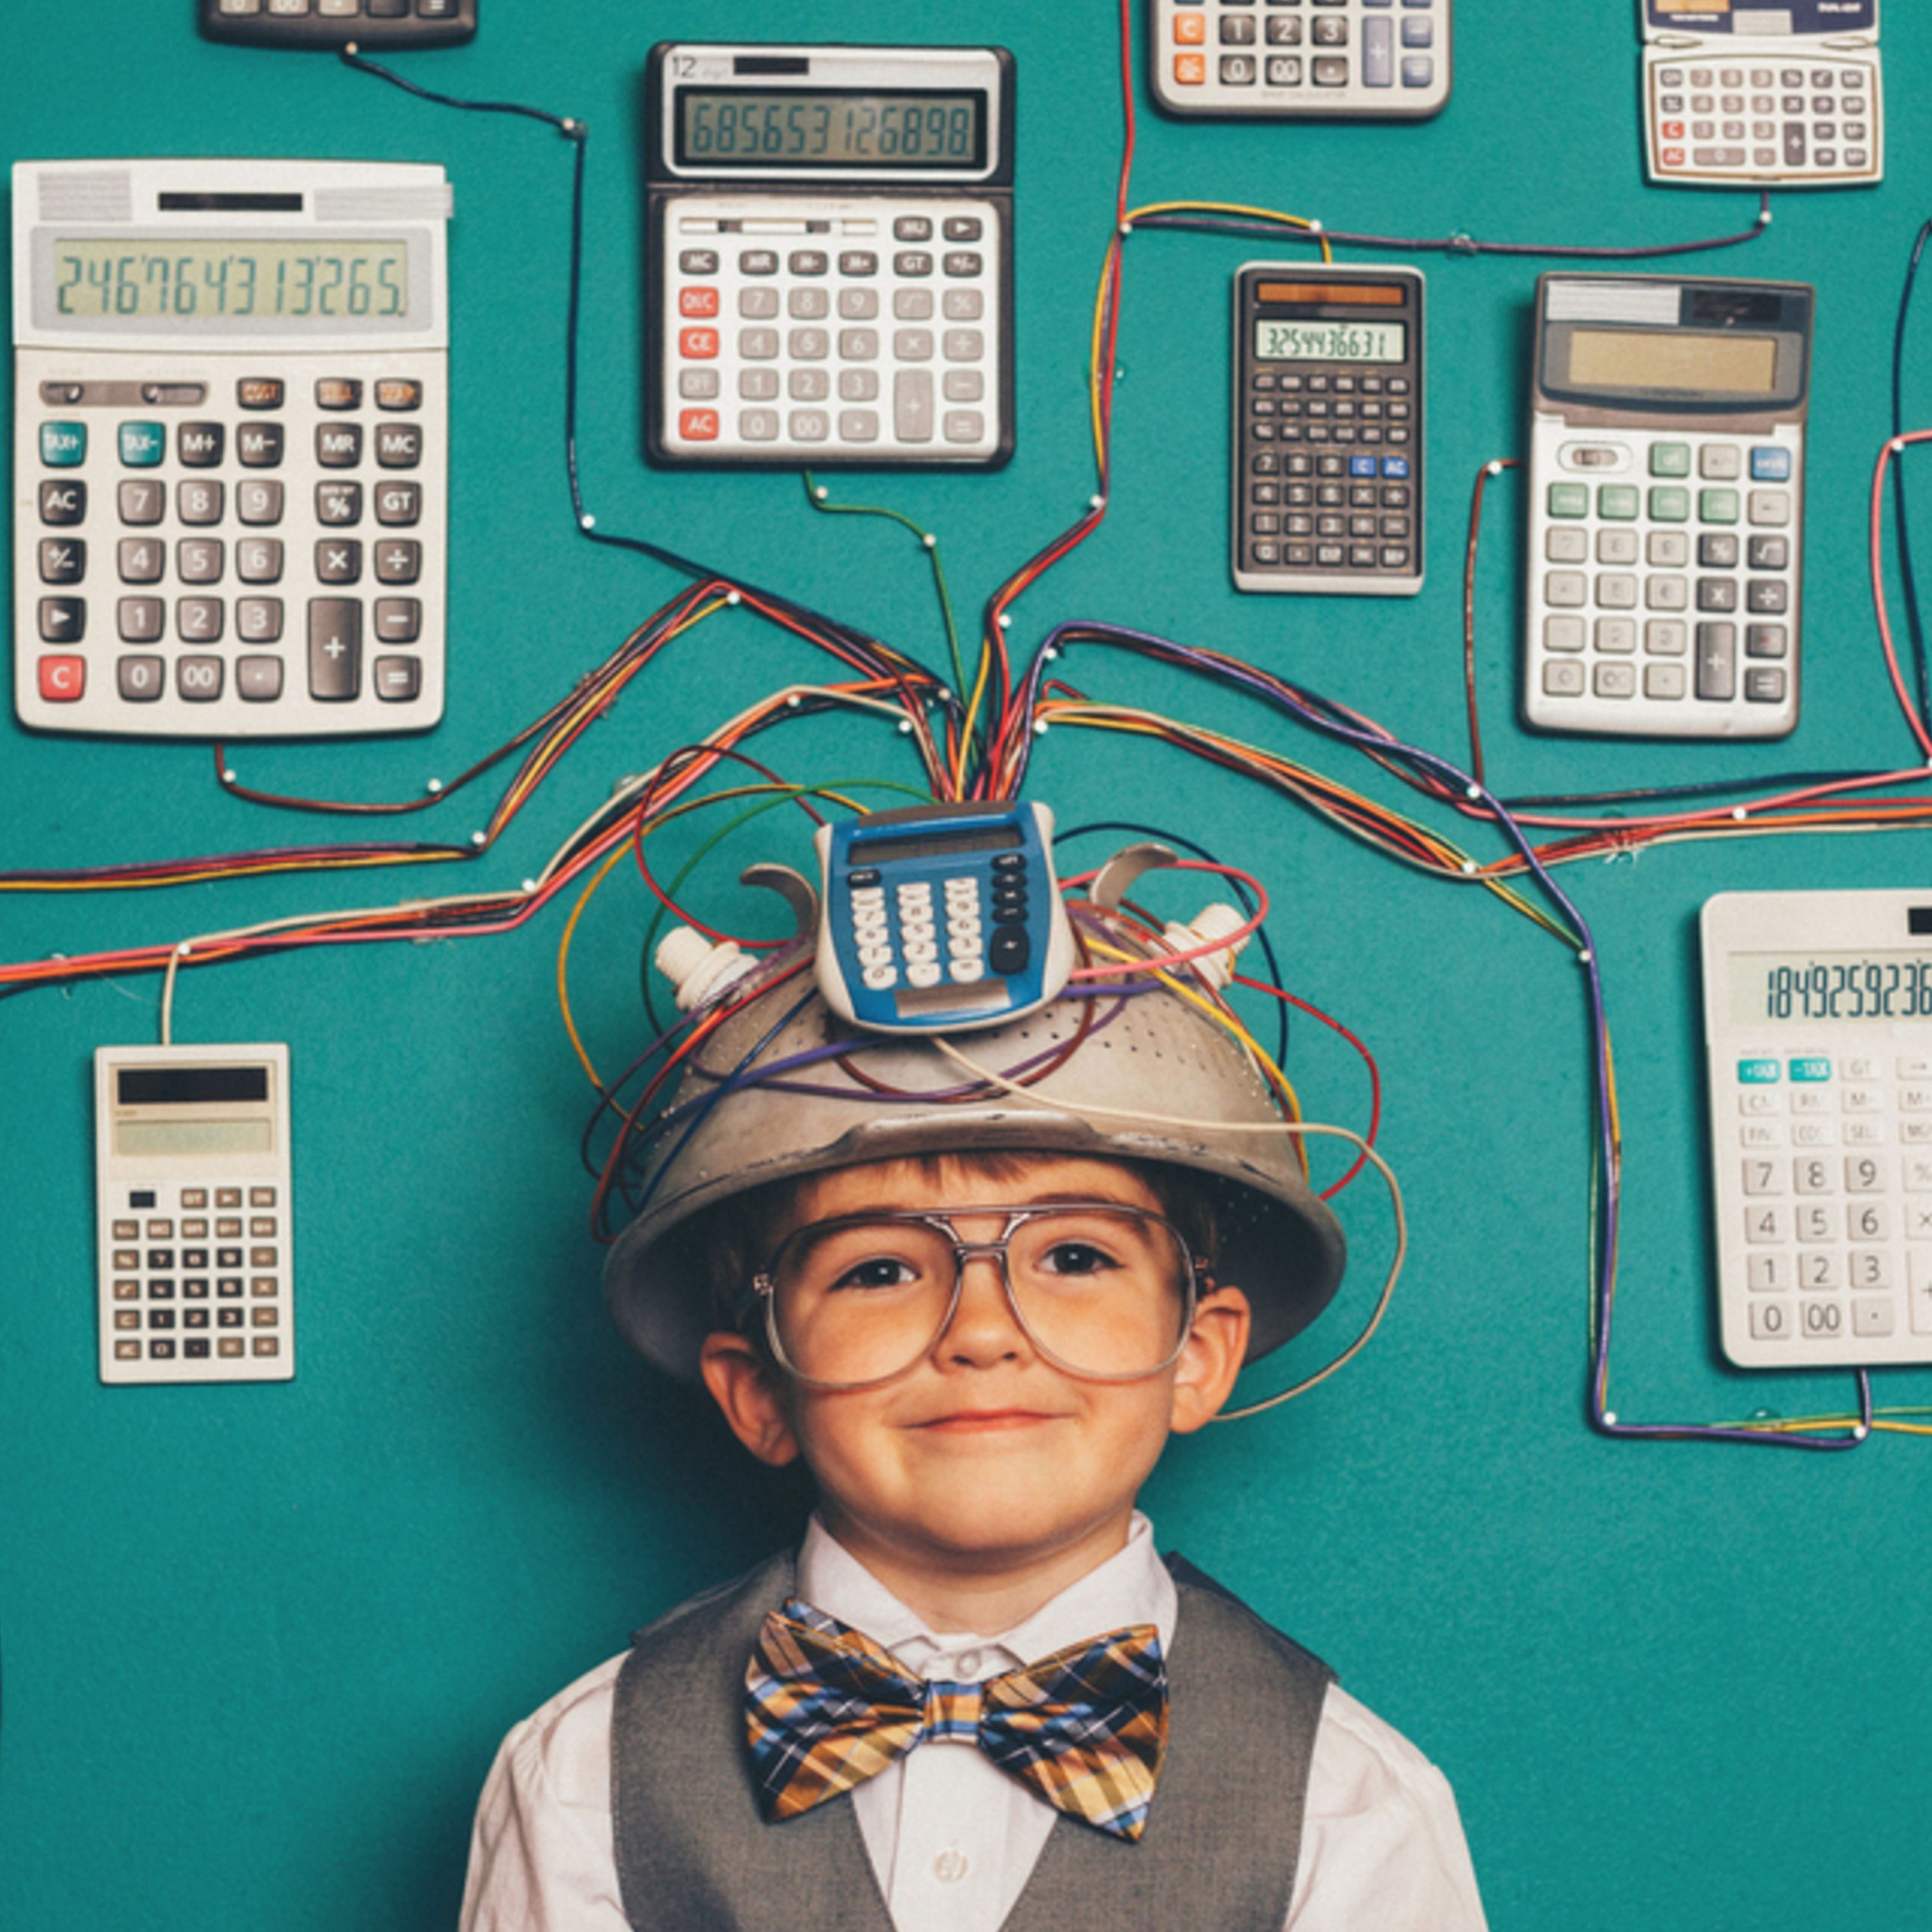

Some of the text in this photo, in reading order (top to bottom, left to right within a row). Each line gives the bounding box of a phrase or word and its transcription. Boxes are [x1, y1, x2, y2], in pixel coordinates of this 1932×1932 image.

[1182, 20, 1196, 37] C
[1233, 21, 1242, 39] 1
[1278, 21, 1293, 41] 2
[1324, 21, 1339, 41] 3
[672, 55, 697, 79] 12
[1231, 60, 1245, 79] 0
[902, 257, 925, 270] GT
[753, 292, 764, 310] 7
[851, 292, 864, 311] 9
[687, 333, 712, 351] CE
[752, 334, 764, 352] 4
[852, 334, 865, 354] 6
[754, 375, 763, 393] 1
[802, 374, 813, 393] 2
[688, 414, 713, 433] AC
[751, 416, 764, 435] 0
[43, 433, 80, 450] TAX+
[183, 433, 216, 451] M+
[323, 433, 355, 453] MR
[383, 434, 415, 453] MC
[46, 491, 77, 510] AC
[133, 488, 149, 512] 7
[191, 488, 209, 512] 8
[251, 488, 269, 513] 9
[383, 491, 412, 511] GT
[131, 547, 149, 569] 4
[193, 548, 208, 571] 5
[251, 547, 269, 571] 6
[135, 606, 146, 629] 1
[192, 605, 207, 629] 2
[252, 606, 267, 630] 3
[52, 666, 70, 689] C
[131, 664, 149, 689] 0
[182, 665, 215, 689] 00
[1757, 1162, 1774, 1188] 7
[1808, 1161, 1825, 1188] 8
[1859, 1159, 1876, 1187] 9
[1759, 1211, 1776, 1236] 4
[1812, 1208, 1827, 1236] 5
[1861, 1208, 1879, 1236] 6
[1764, 1258, 1775, 1284] 1
[1814, 1256, 1830, 1284] 2
[1865, 1255, 1880, 1283] 3
[1764, 1305, 1782, 1332] 0
[1808, 1303, 1841, 1331] 00
